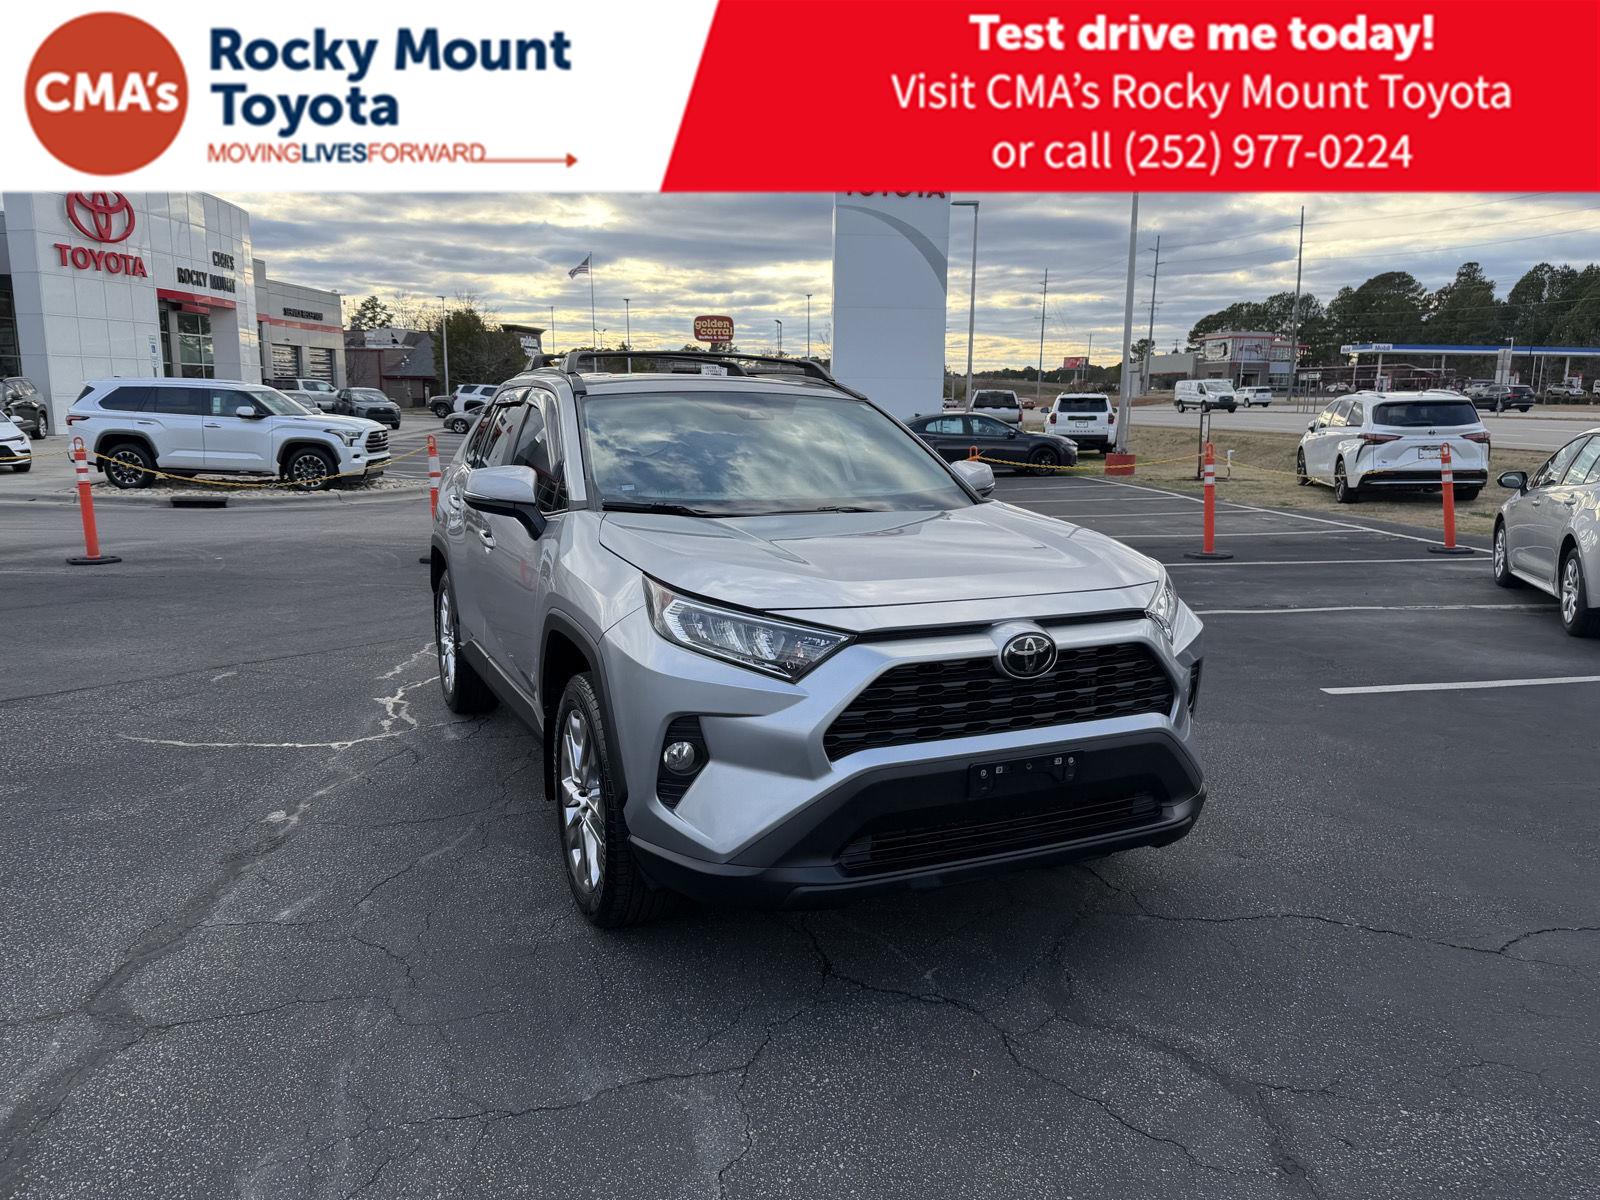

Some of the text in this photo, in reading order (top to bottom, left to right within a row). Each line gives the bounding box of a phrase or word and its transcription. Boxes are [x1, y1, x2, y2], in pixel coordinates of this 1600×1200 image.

[54, 243, 148, 278] TOYOTA
[177, 266, 208, 288] ROCKY
[695, 319, 730, 329] golden
[700, 327, 733, 335] corral
